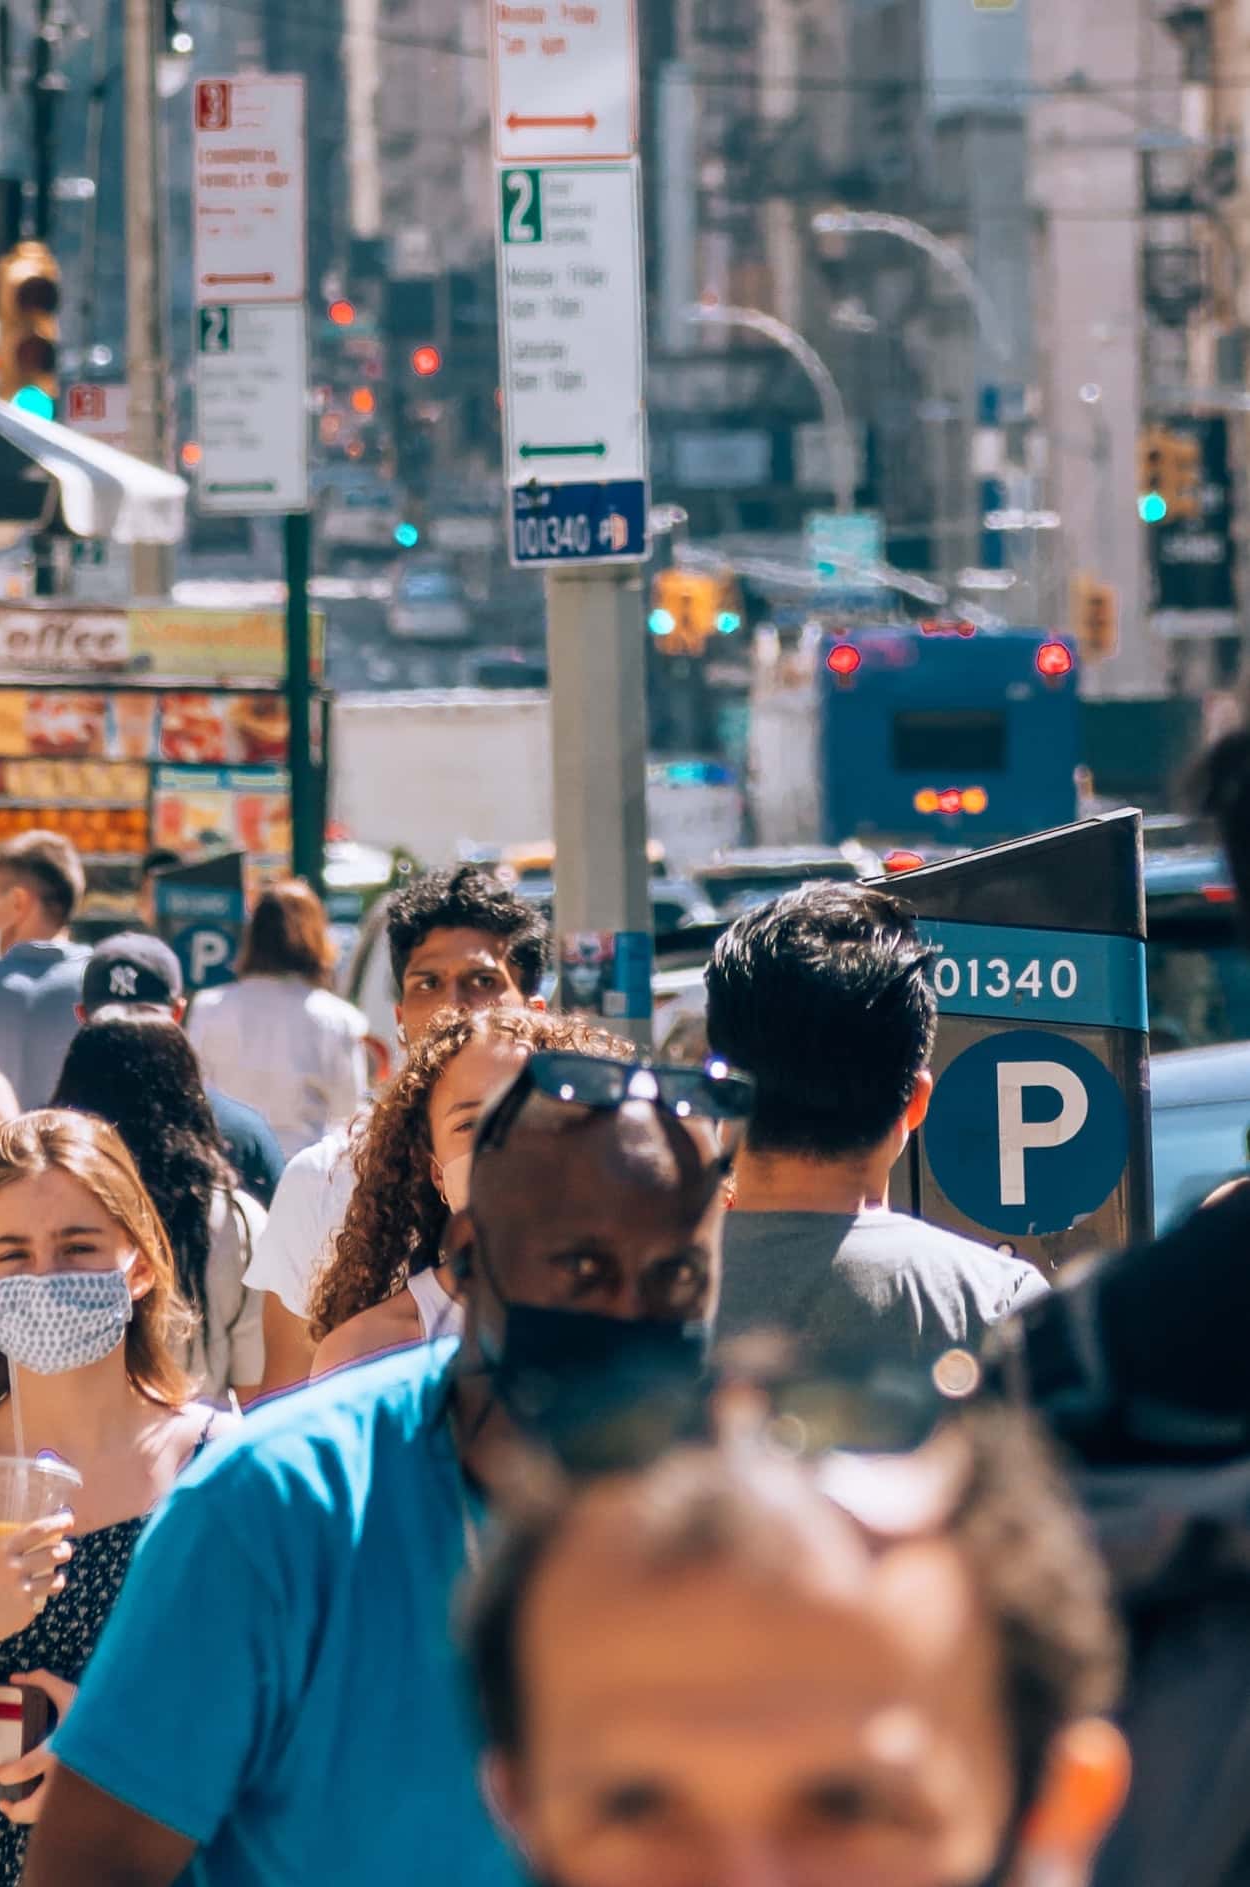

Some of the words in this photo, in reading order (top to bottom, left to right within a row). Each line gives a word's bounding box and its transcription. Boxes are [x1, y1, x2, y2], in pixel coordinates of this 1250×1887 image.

[506, 171, 535, 241] 2
[204, 310, 225, 351] 2
[517, 513, 591, 556] 101340
[190, 930, 229, 984] P
[933, 958, 1078, 998] 01340
[108, 965, 139, 997] NY
[997, 1061, 1088, 1206] P
